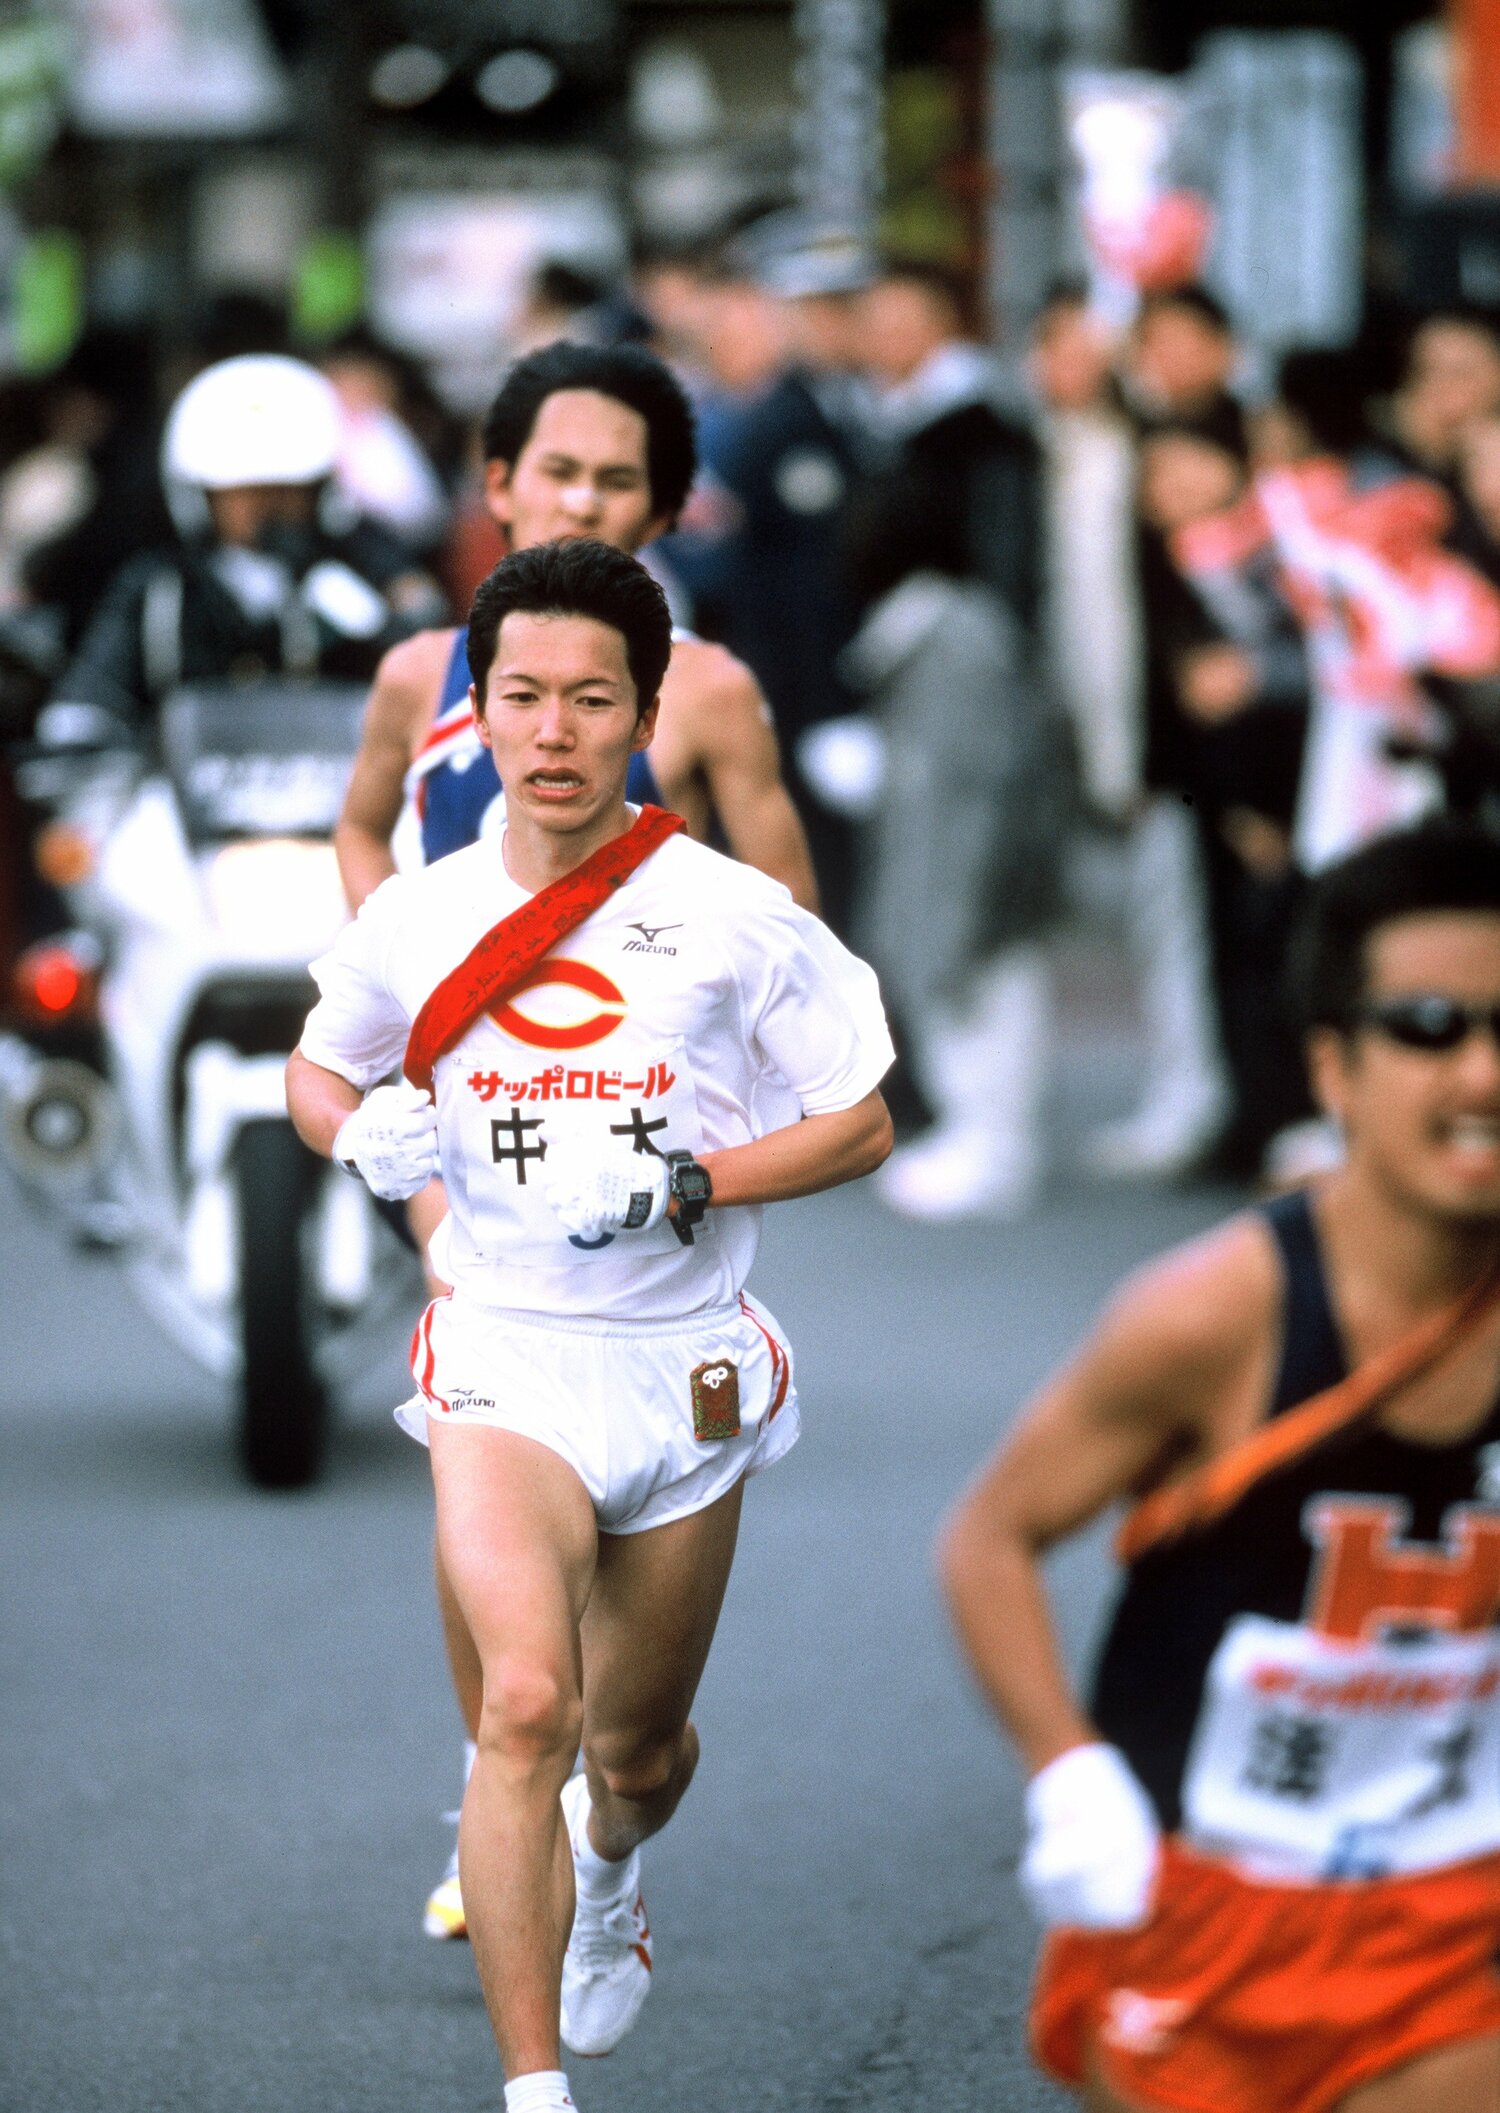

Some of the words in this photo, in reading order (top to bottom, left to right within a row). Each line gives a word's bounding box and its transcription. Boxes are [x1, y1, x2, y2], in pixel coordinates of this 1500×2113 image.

[622, 940, 677, 957] MIZUNO
[467, 1062, 676, 1102] サッポロビール
